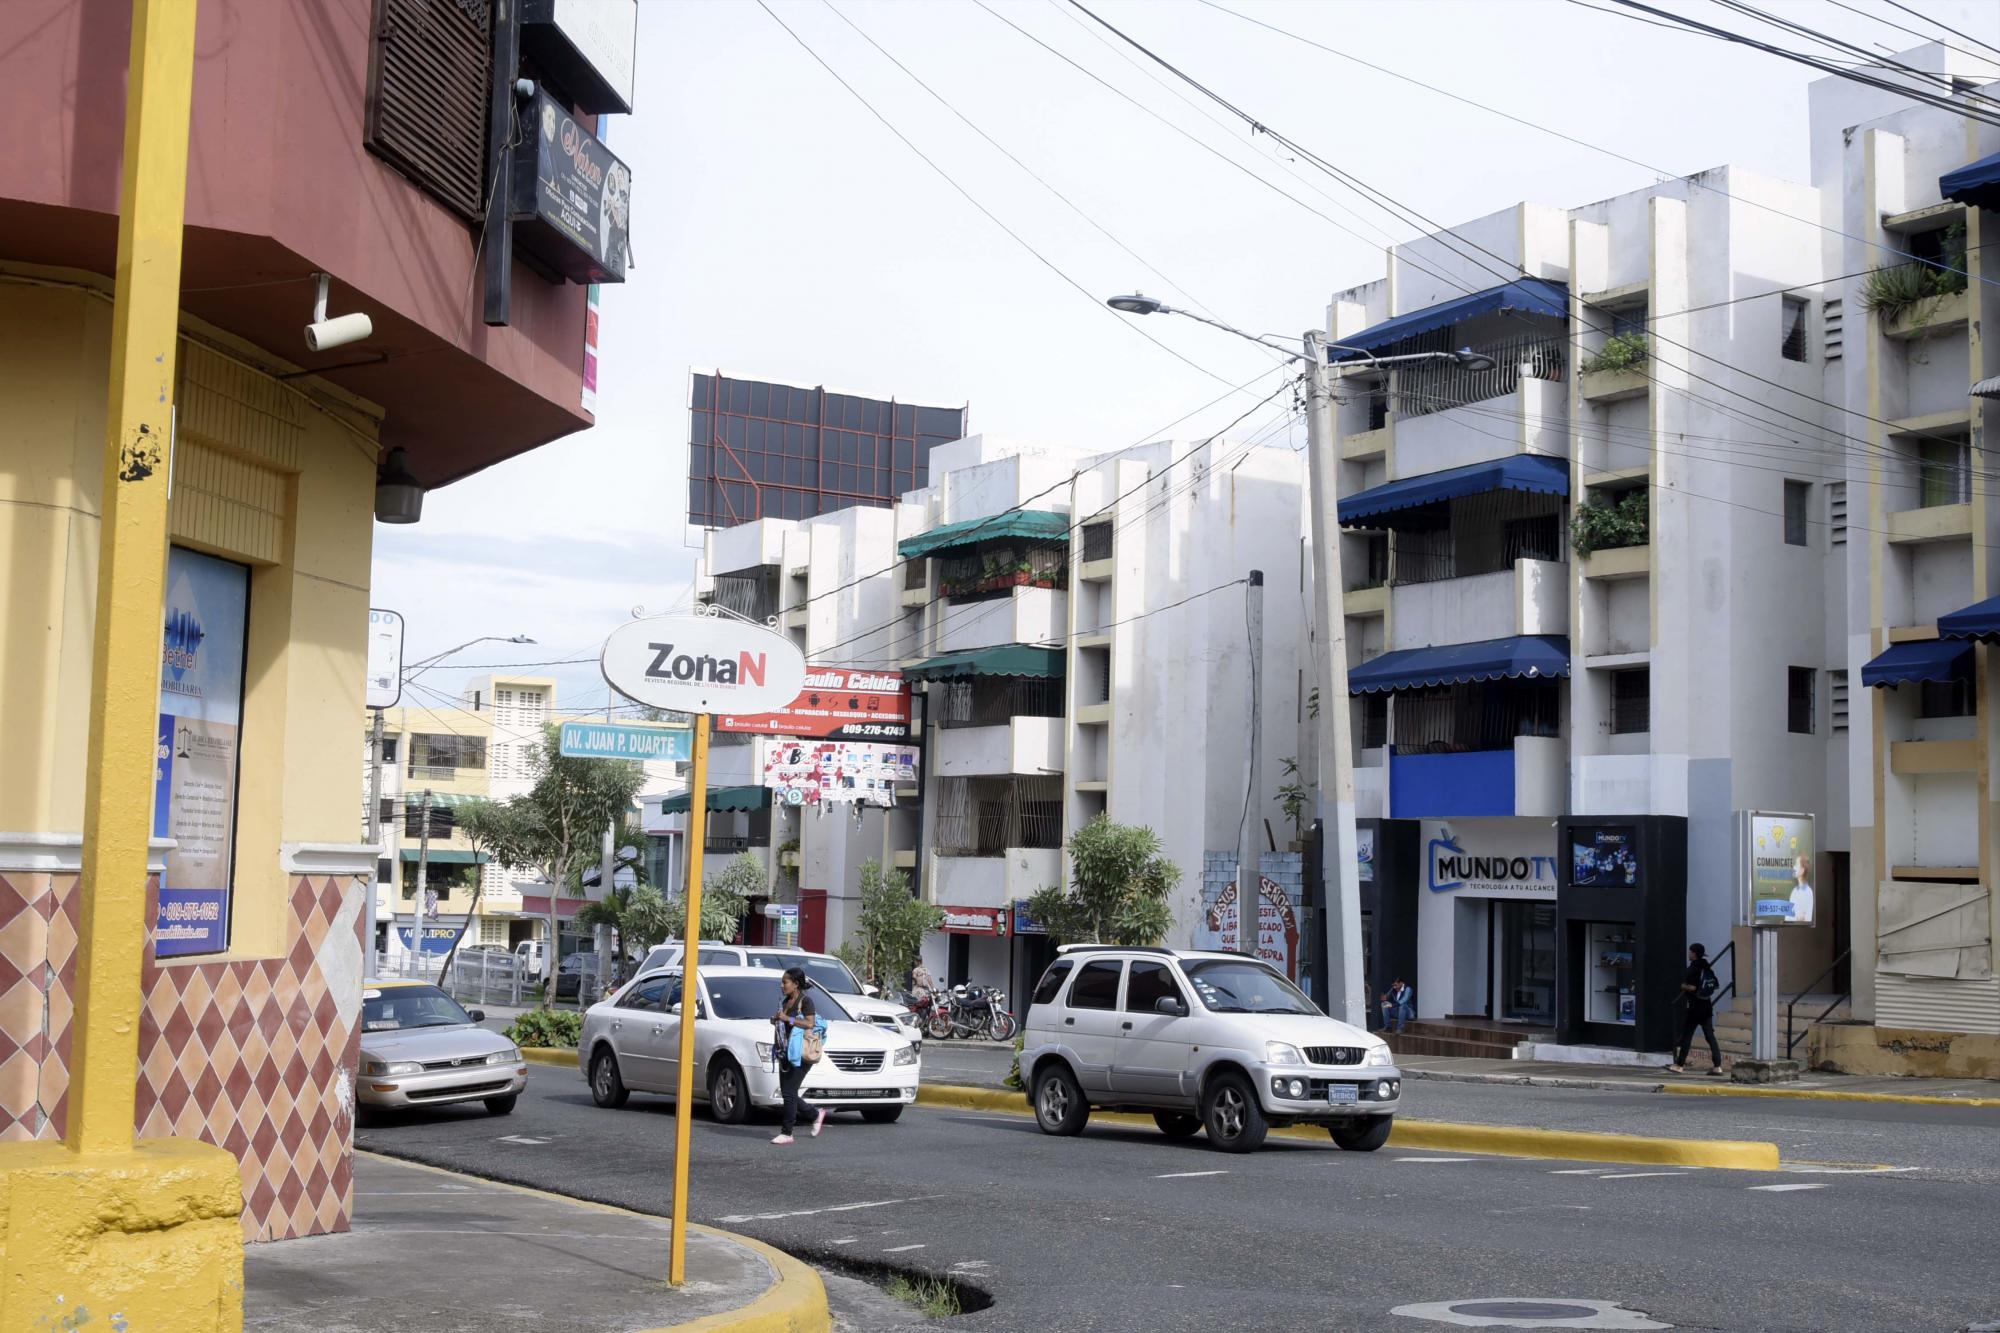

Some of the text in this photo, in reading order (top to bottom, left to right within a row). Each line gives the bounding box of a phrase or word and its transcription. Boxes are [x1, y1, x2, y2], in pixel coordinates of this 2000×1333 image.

[645, 642, 766, 687] ZonaN
[847, 673, 900, 691] Celular
[842, 724, 906, 737] 809-276-4745
[566, 730, 675, 755] AV. JUAN P. DUARTE
[1525, 884, 1556, 893] ALCANCE
[1259, 921, 1282, 932] ECADO
[1261, 933, 1274, 944] LA
